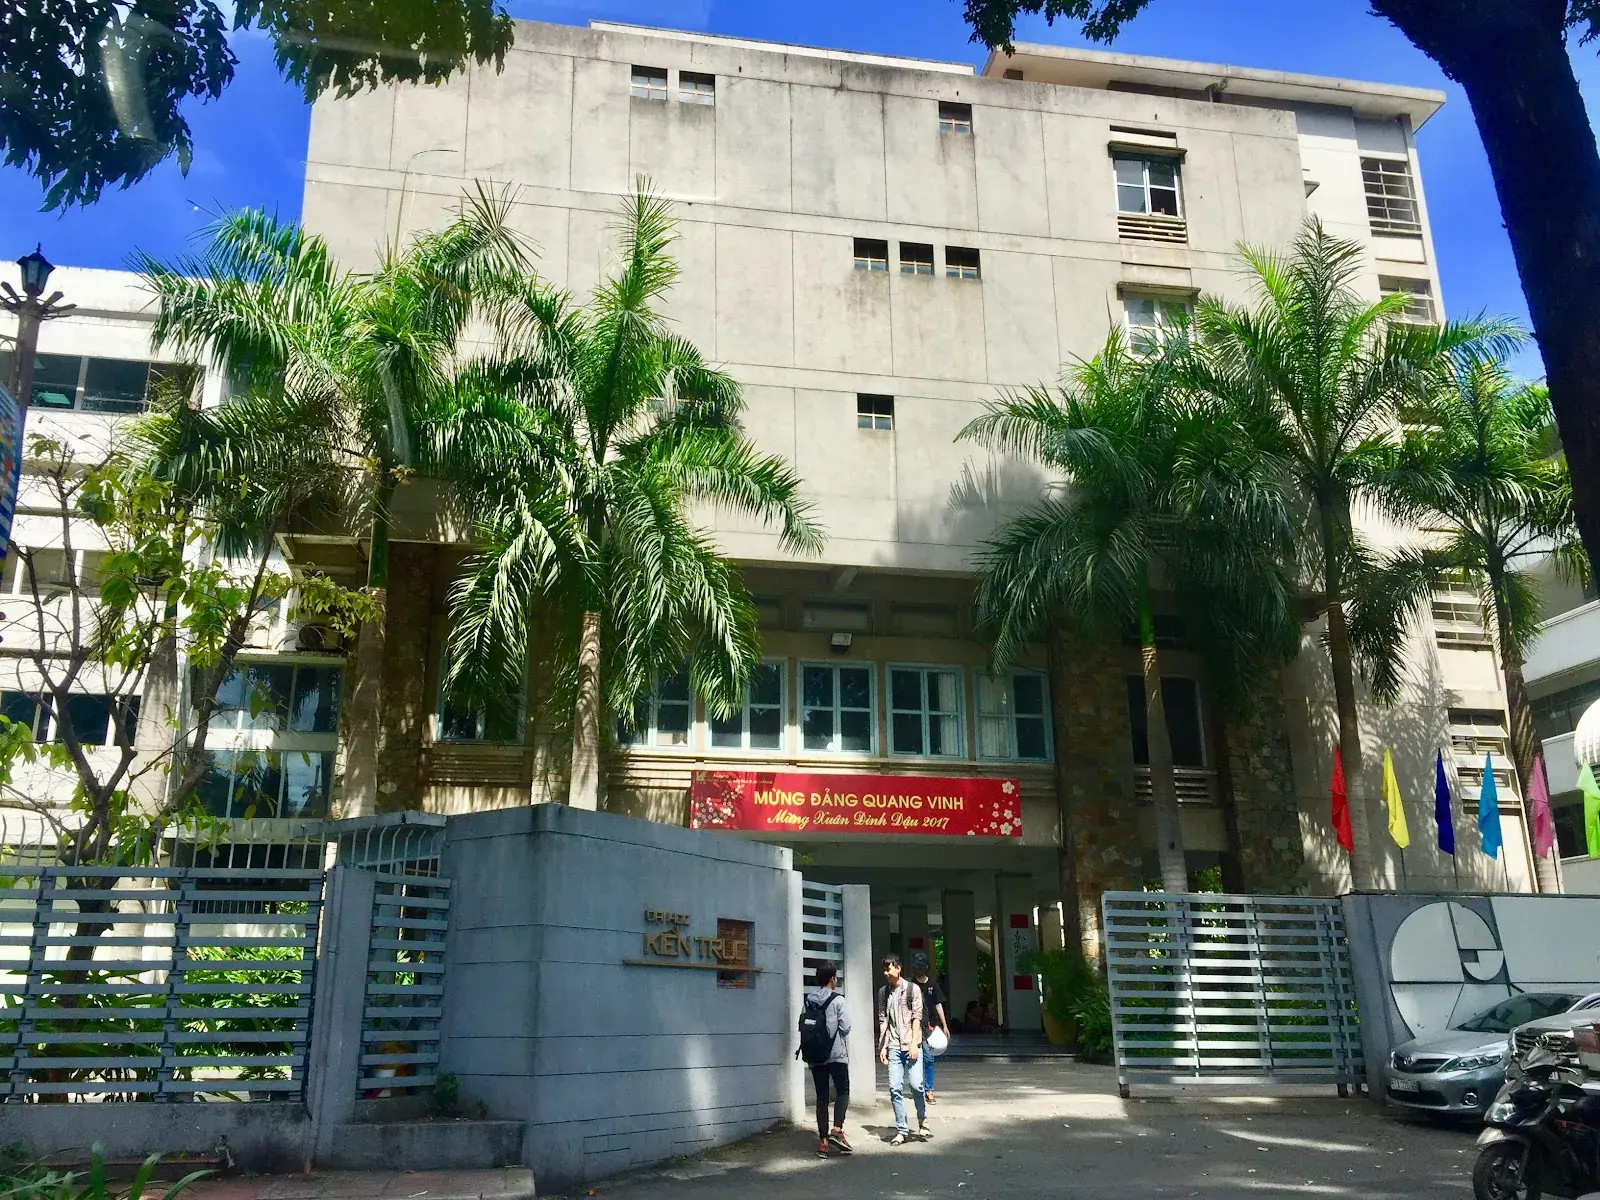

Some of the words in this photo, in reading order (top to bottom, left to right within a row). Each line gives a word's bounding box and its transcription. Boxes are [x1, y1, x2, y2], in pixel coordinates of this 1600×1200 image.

[754, 787, 806, 807] MỪNG
[810, 787, 859, 808] ĐẢNG
[862, 793, 923, 810] QUANG
[927, 795, 964, 811] VINH
[767, 809, 810, 830] Mừng
[813, 810, 850, 826] Xuân
[853, 811, 888, 827] Đinh
[891, 811, 919, 830] Dậu
[922, 816, 950, 830] 2017
